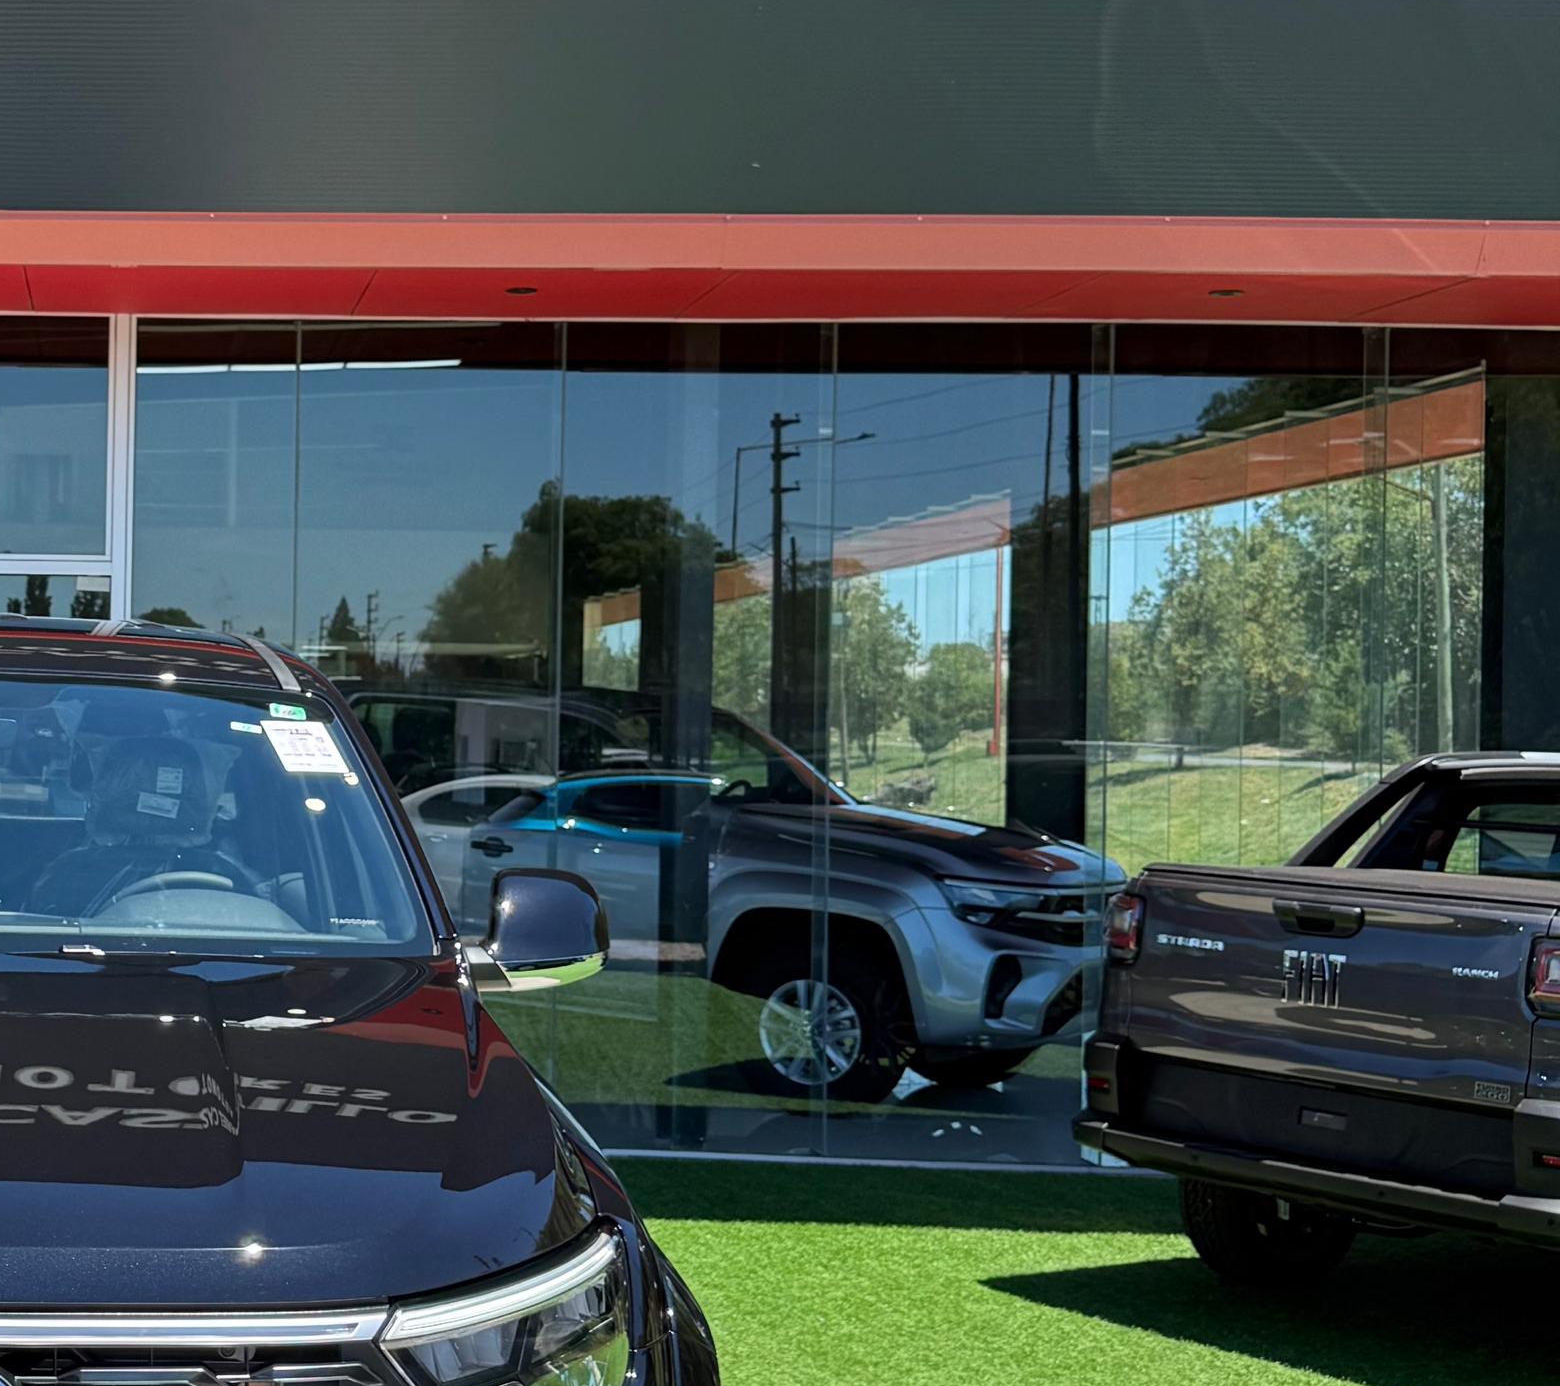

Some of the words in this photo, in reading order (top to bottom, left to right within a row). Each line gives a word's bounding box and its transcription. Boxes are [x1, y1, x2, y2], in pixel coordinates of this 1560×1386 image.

[1156, 933, 1225, 952] STRADA
[1280, 949, 1347, 1009] FIAT
[1452, 967, 1499, 981] RANCH
